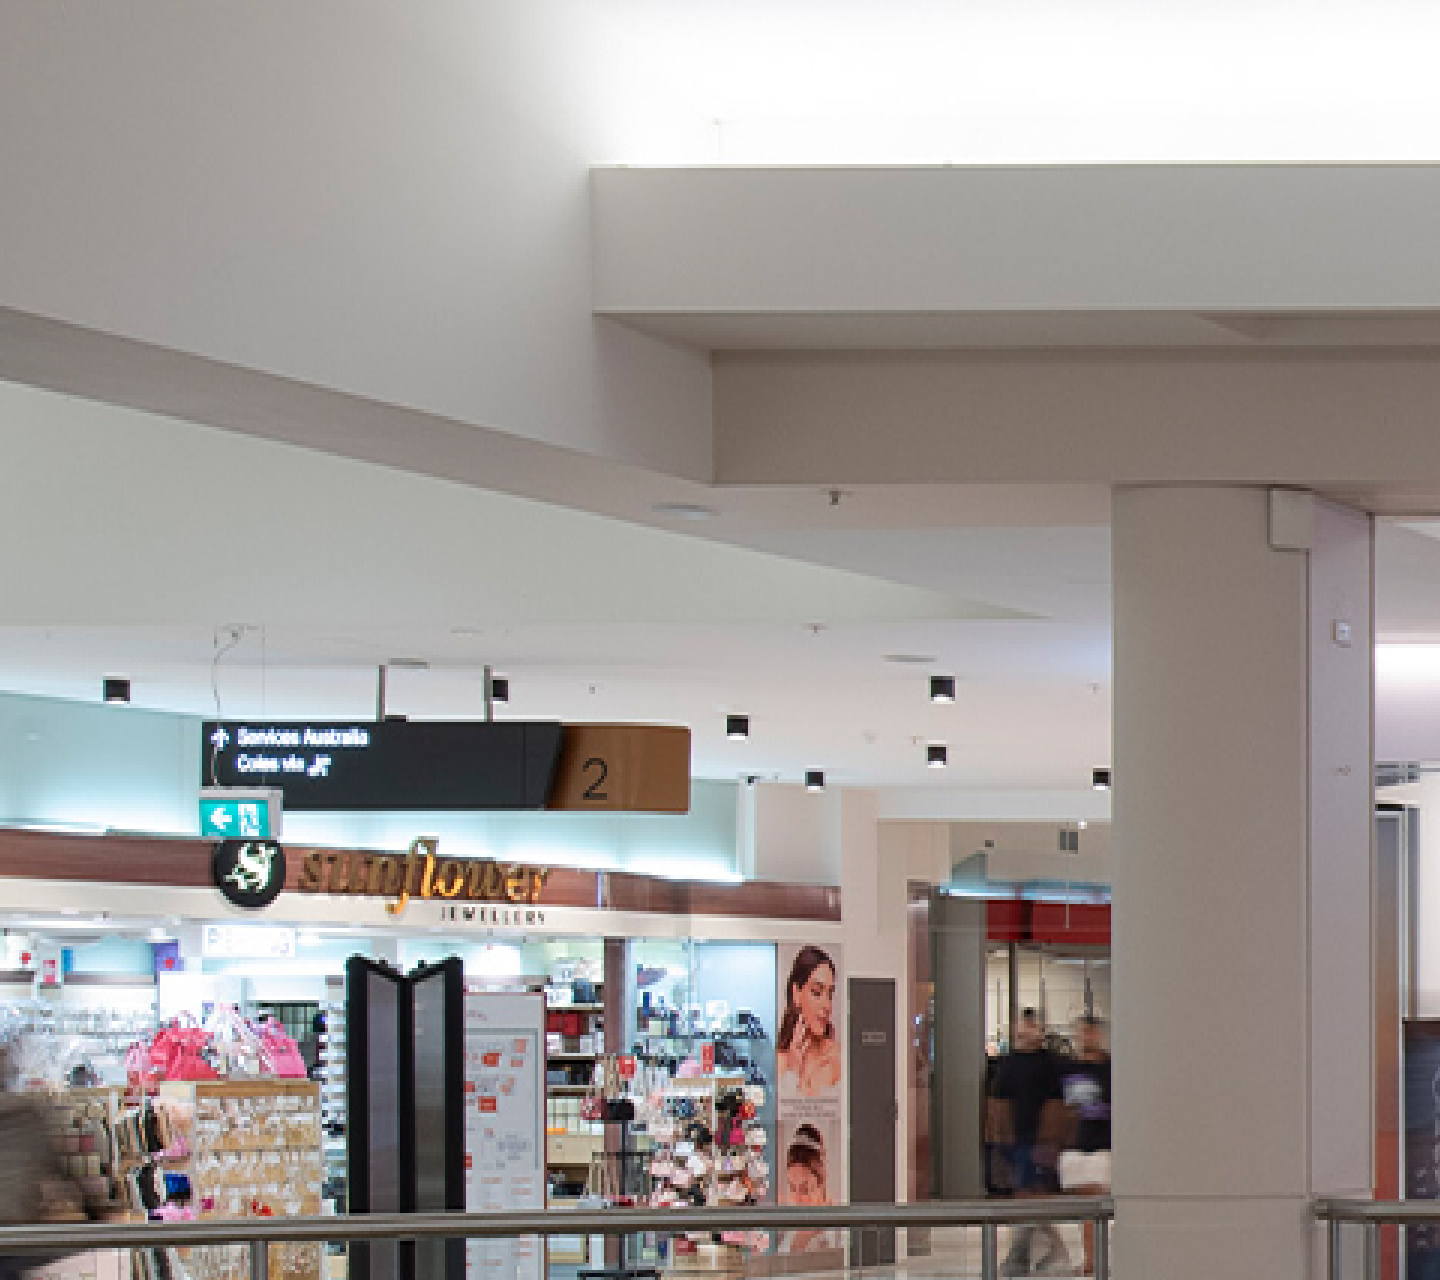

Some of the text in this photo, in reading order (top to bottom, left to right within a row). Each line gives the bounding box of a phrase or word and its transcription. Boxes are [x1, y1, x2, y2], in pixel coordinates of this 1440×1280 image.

[581, 757, 608, 800] 2
[298, 837, 550, 915] sunflower
[440, 906, 546, 926] JEWELLERY
